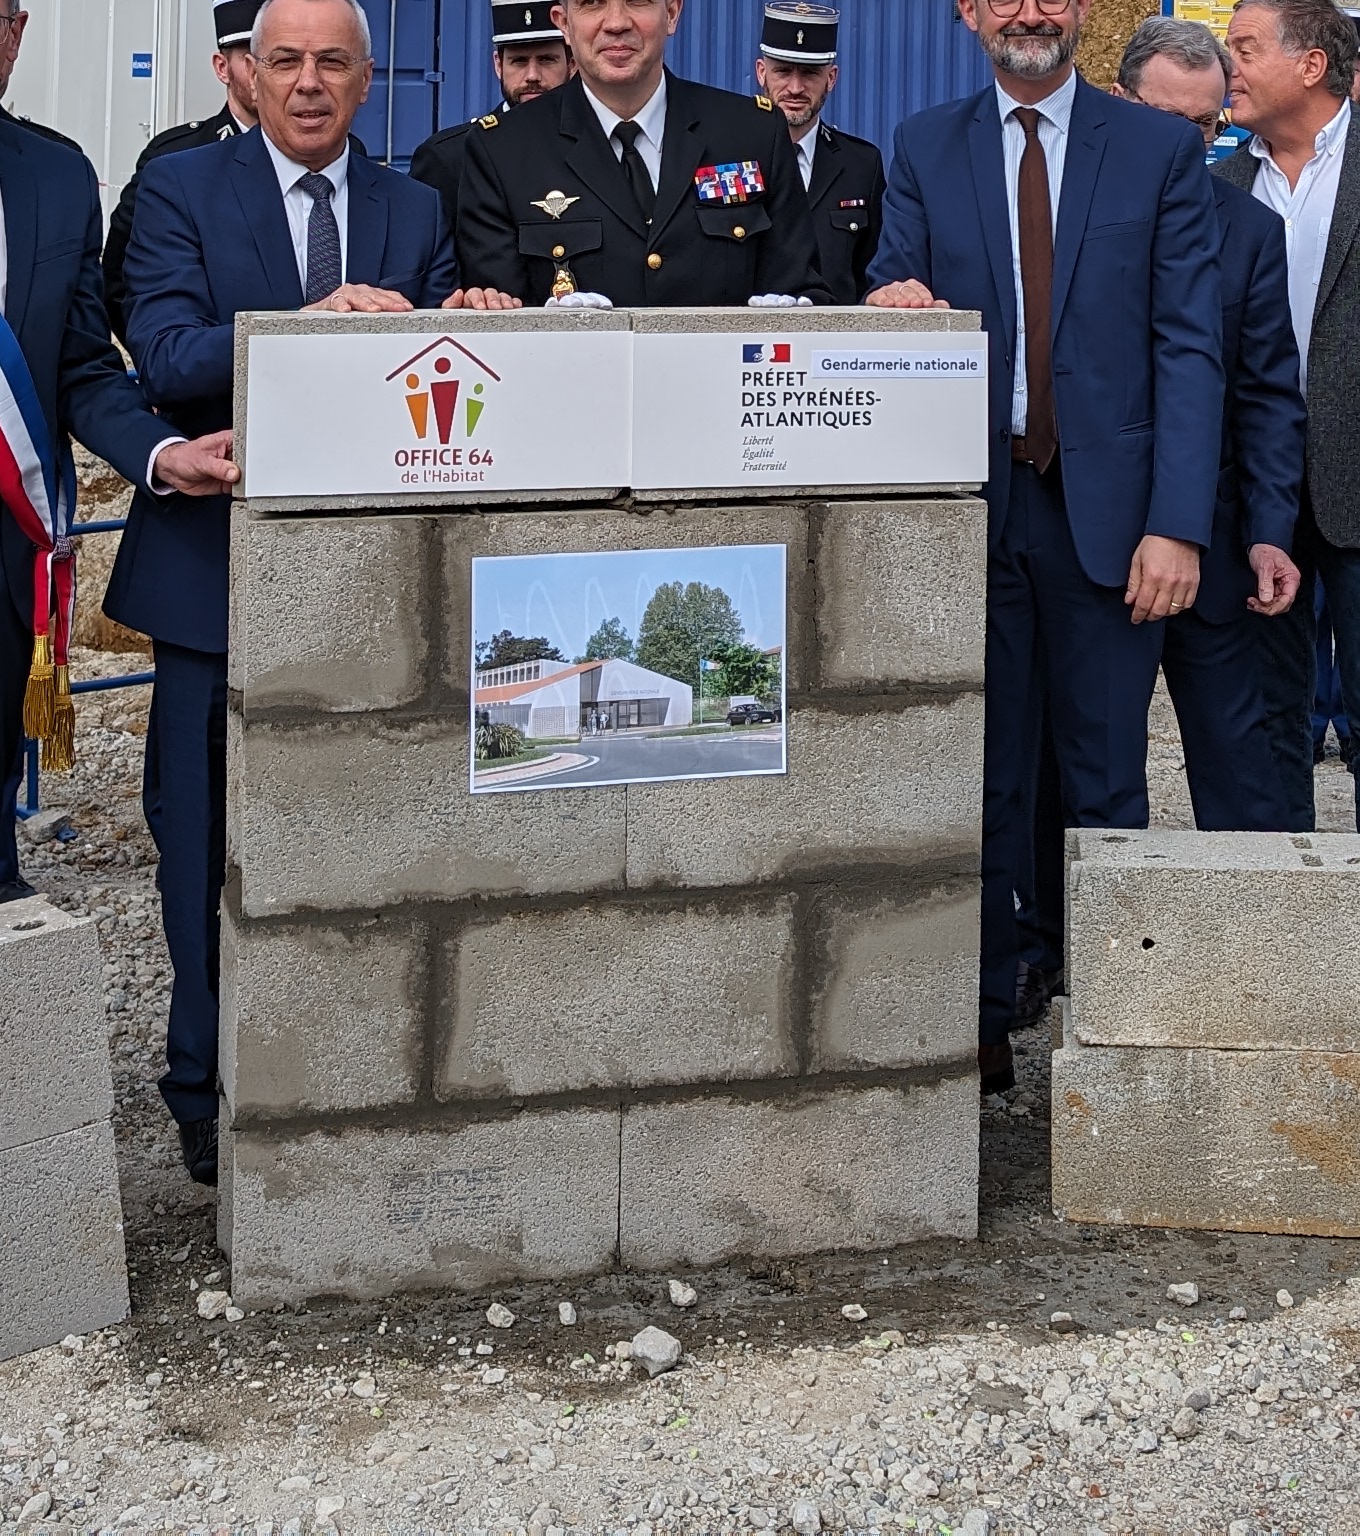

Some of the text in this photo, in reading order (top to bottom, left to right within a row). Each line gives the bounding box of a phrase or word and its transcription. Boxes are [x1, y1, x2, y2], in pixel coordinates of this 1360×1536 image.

[821, 357, 978, 371] Gendarmerie nationale
[742, 368, 807, 387] PRÉFET
[742, 387, 882, 407] DES PYRÉNÉES-
[740, 410, 872, 429] ATLANTIQUES
[742, 435, 774, 446] Liberté
[394, 447, 494, 467] OFFICE 64
[742, 447, 774, 460] Égalité
[742, 461, 788, 472] Fraternité
[401, 469, 485, 483] de l'Habitat
